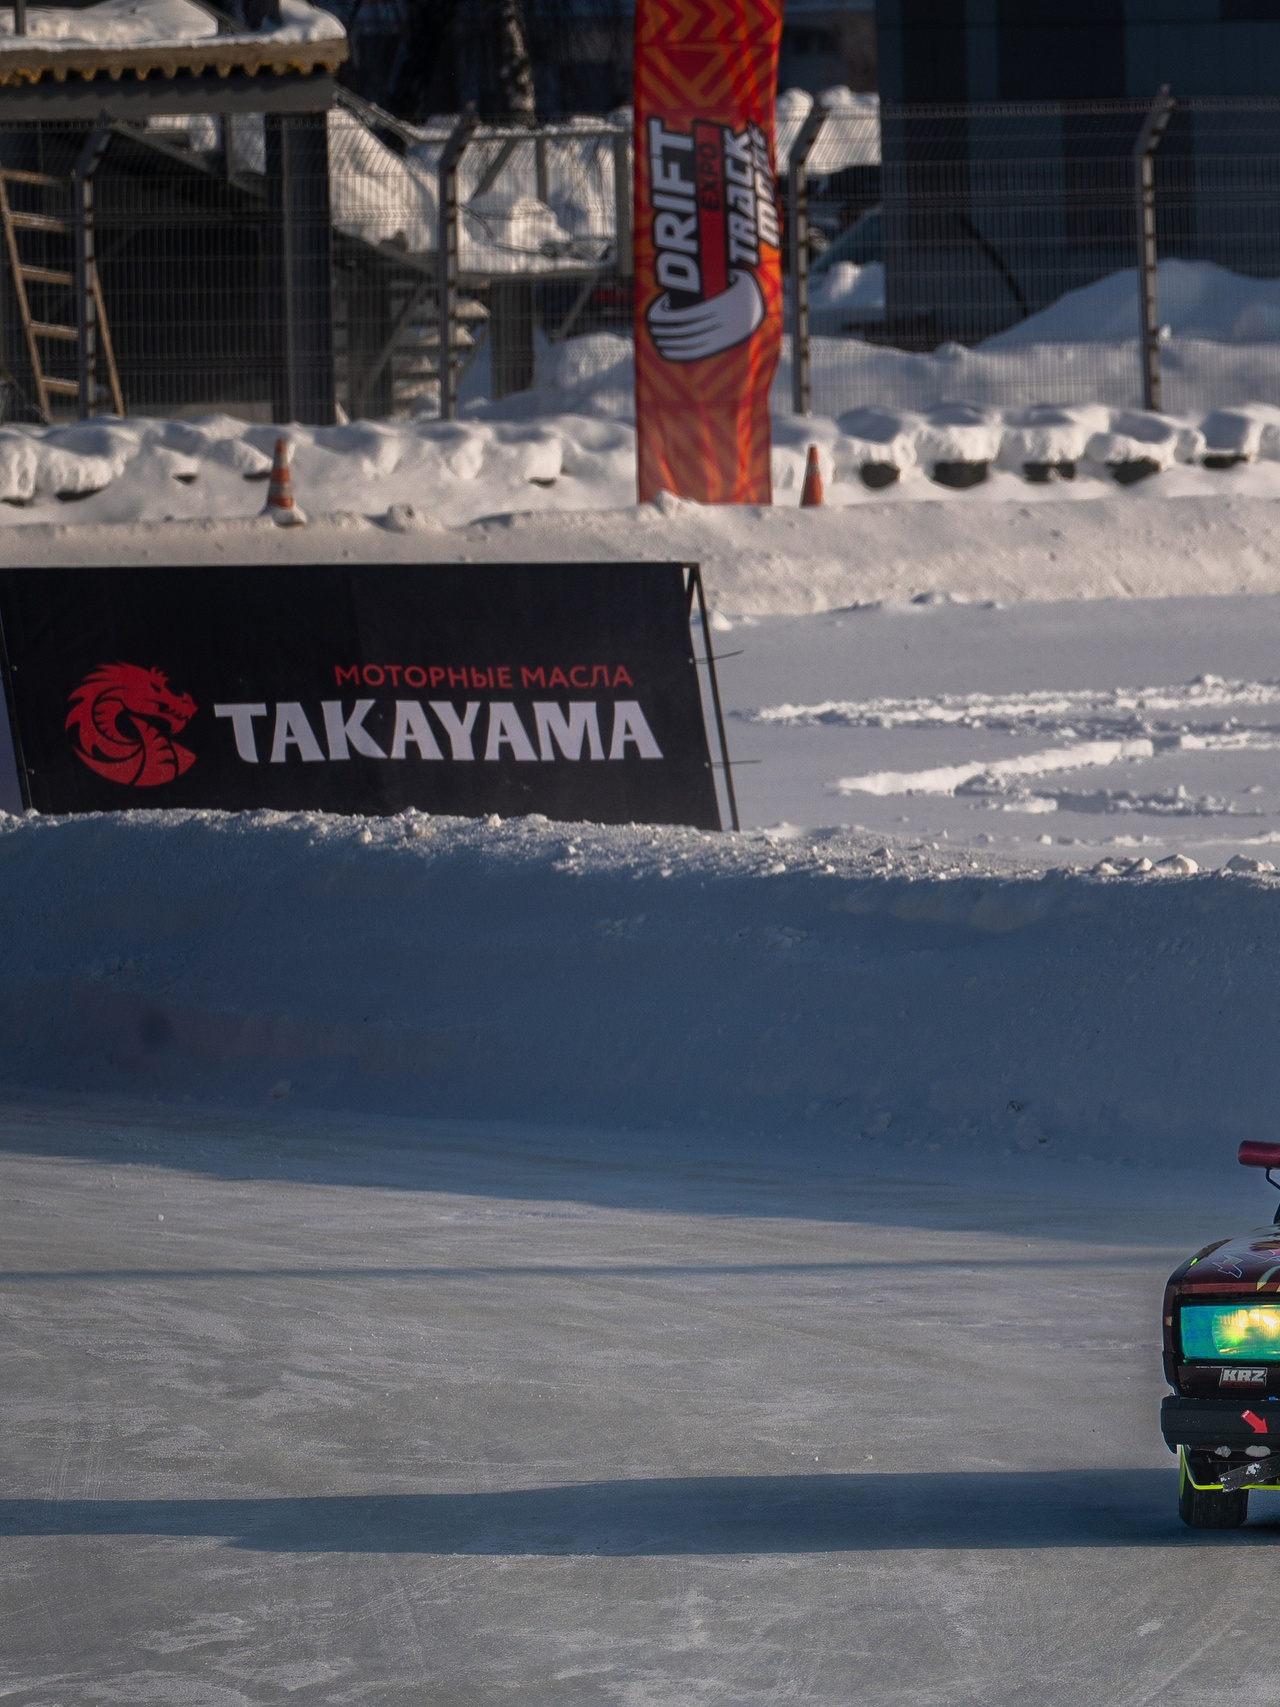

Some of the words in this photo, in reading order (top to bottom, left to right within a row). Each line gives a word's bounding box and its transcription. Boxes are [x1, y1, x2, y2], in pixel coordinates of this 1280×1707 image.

[650, 117, 701, 293] DRIFT
[702, 141, 720, 212] EXPO
[333, 664, 514, 689] МОТОРНЫЕ
[521, 664, 634, 689] МАСЛА
[213, 699, 664, 763] TAKAYAMA
[1222, 1369, 1266, 1382] KRZ
